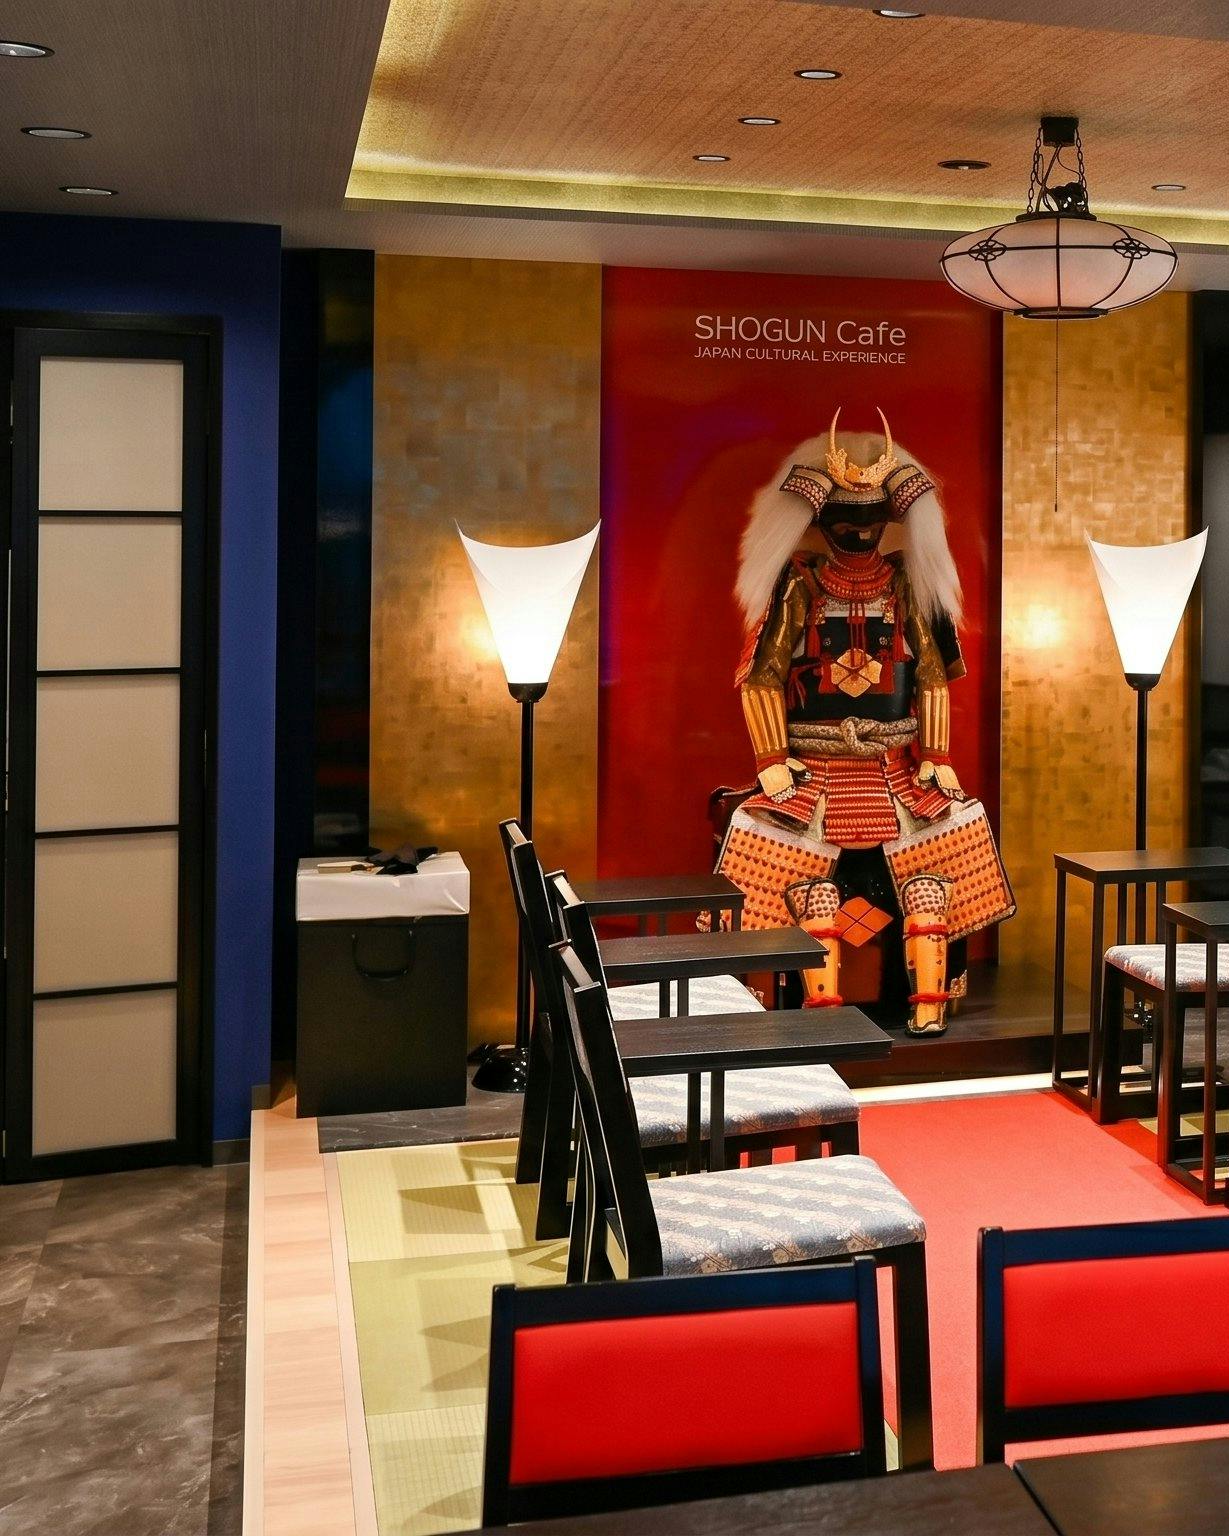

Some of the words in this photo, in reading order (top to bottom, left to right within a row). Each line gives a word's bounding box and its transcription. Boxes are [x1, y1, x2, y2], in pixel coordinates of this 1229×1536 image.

[694, 314, 826, 343] SHOGUN
[836, 320, 906, 346] Cafe
[694, 346, 742, 359] JAPAN
[745, 348, 819, 361] CULTURAL
[823, 350, 906, 364] EXPERIENCE
